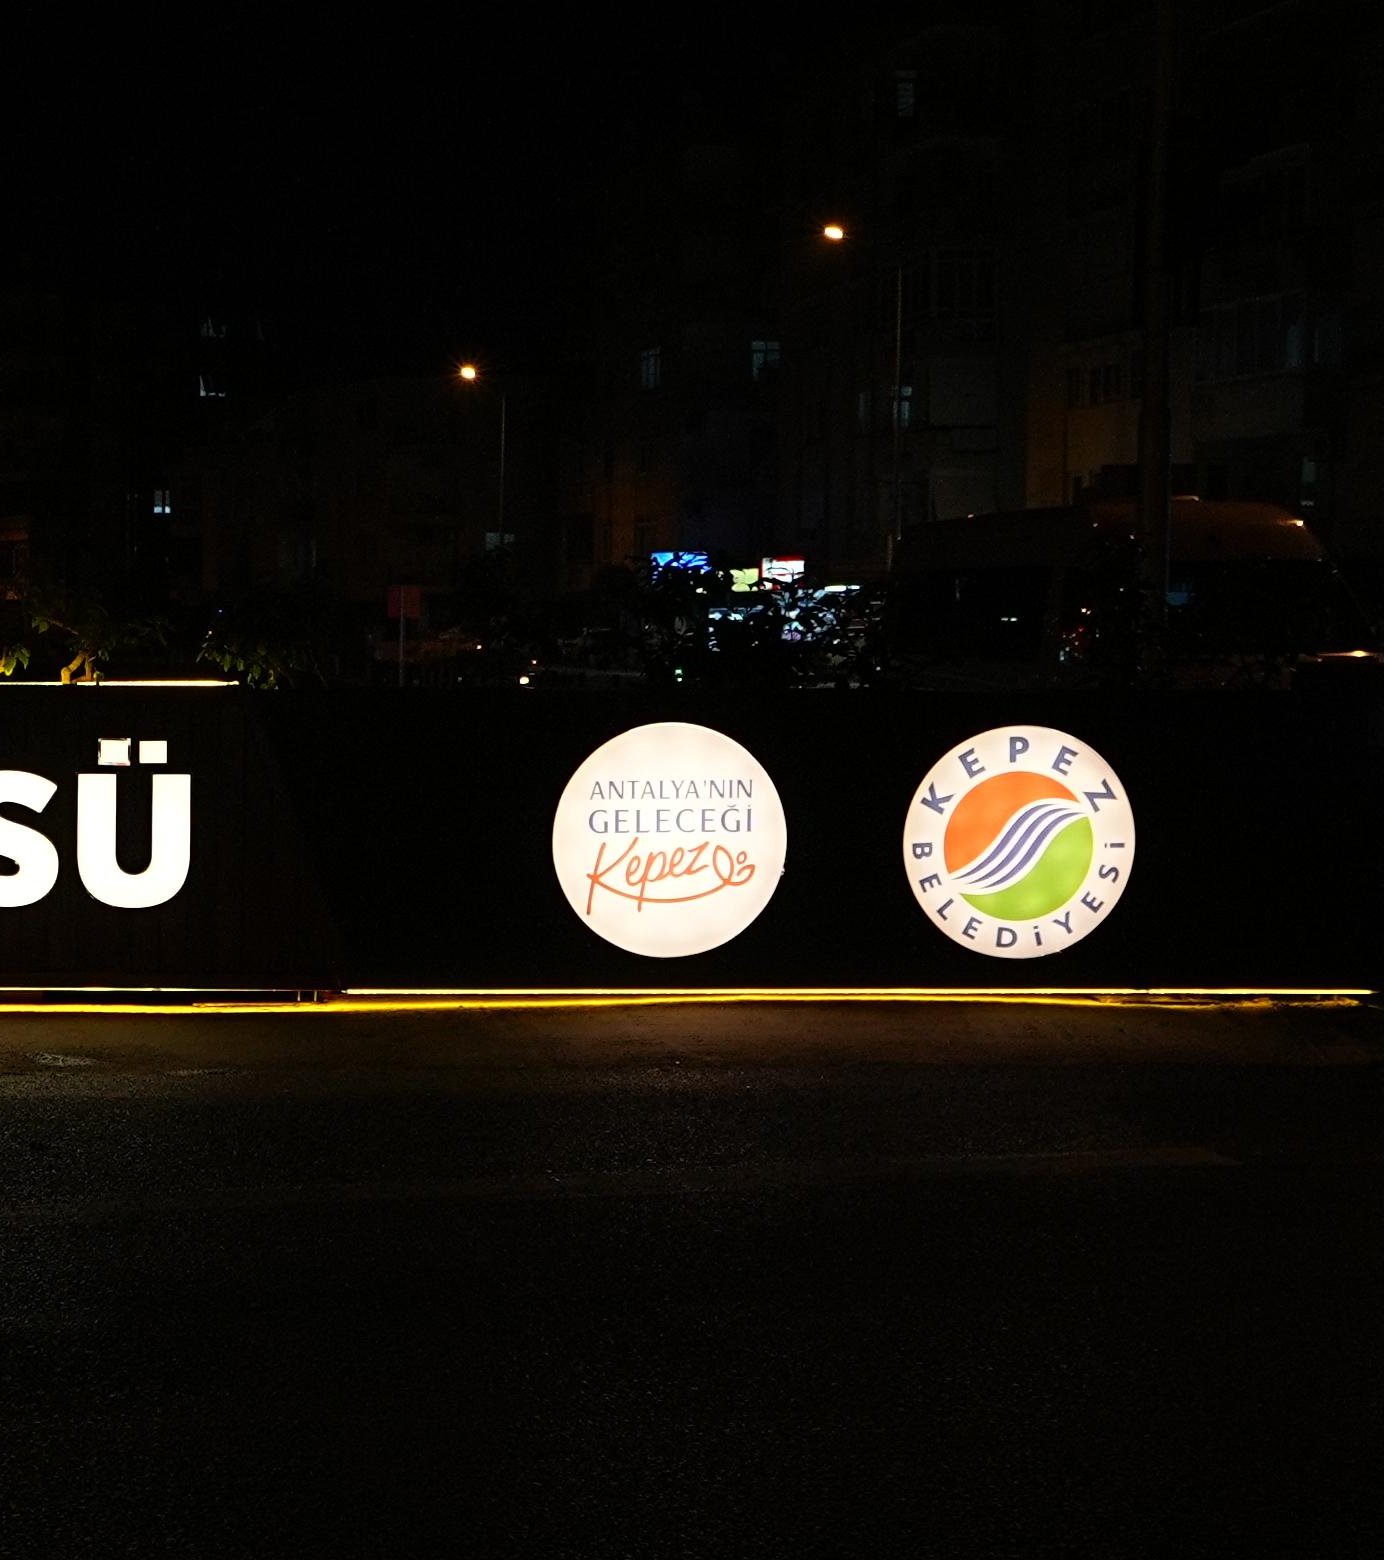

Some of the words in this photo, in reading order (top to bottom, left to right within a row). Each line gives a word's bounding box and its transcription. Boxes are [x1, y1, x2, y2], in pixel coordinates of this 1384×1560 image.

[590, 779, 754, 800] ANTALYA'NIN
[920, 736, 1118, 814] KEPEZ
[588, 804, 753, 834] GELECEĞİ
[586, 837, 714, 915] Kepez
